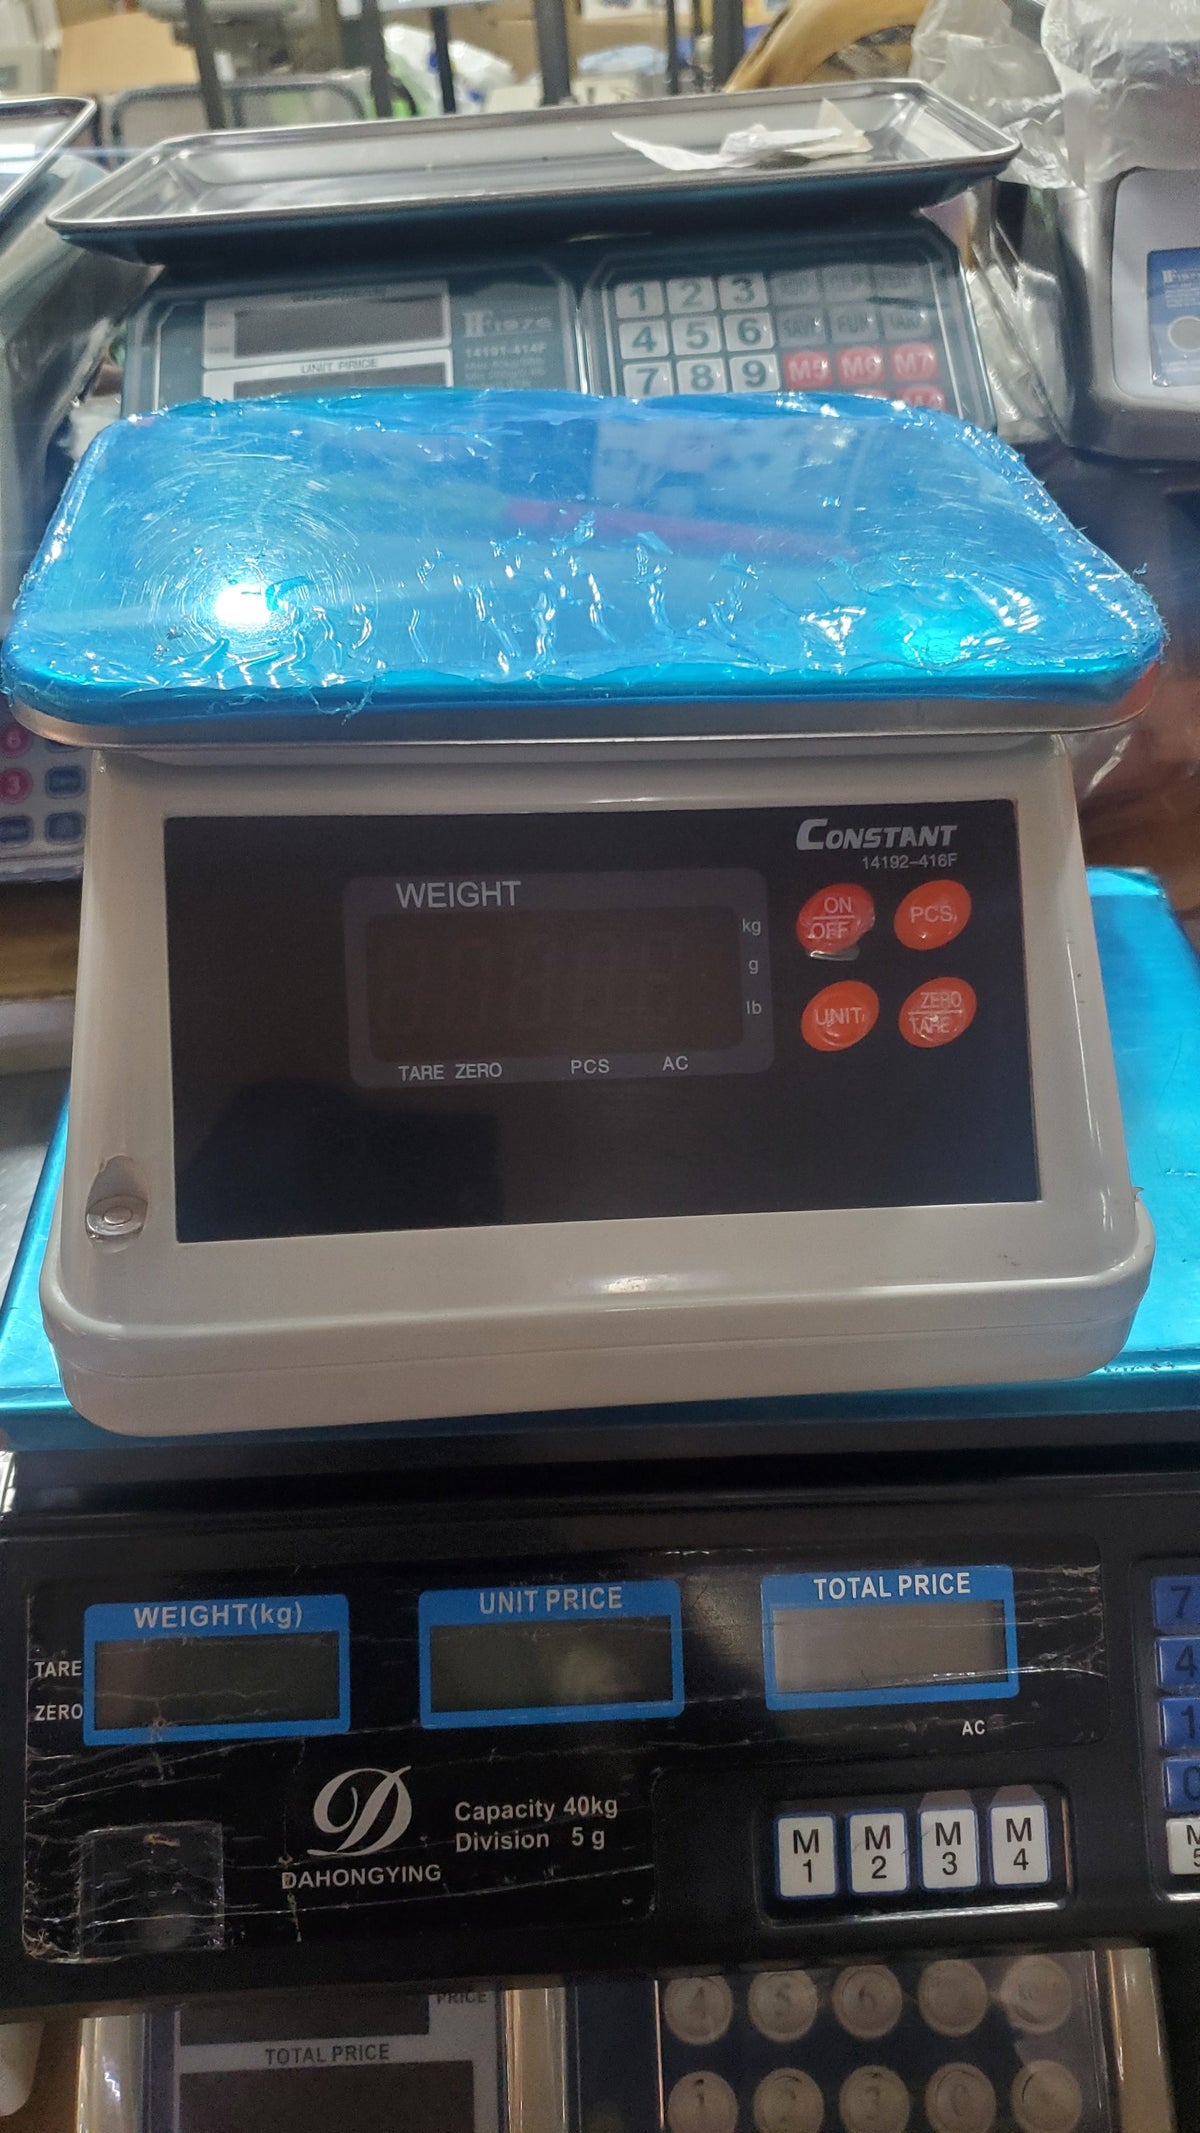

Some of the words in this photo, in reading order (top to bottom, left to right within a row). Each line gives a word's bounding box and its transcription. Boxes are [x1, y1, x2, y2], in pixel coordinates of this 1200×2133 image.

[629, 287, 646, 312] 1
[681, 281, 700, 308] 2
[734, 278, 755, 303] 3
[632, 326, 656, 351] 4
[686, 322, 709, 349] 5
[737, 318, 761, 345] 6
[301, 361, 332, 374] UNIT
[337, 358, 378, 370] PRICE
[894, 352, 935, 375] M7
[637, 368, 659, 395] 7
[690, 364, 714, 391] 8
[742, 360, 766, 387] 9
[796, 818, 958, 850] CONSTANT
[395, 880, 522, 909] WEIGHT
[823, 897, 853, 914] ON
[910, 905, 953, 924] PCS
[742, 918, 761, 936] kg
[811, 921, 849, 940] OFF
[748, 960, 759, 974] g
[746, 1000, 762, 1015] lb
[921, 990, 962, 1010] ZERO
[814, 1007, 863, 1026] UNIT
[909, 1017, 950, 1034] TARE
[399, 1065, 444, 1082] TARE
[455, 1062, 502, 1080] ZERO
[570, 1059, 610, 1075] PCS
[662, 1056, 689, 1071] AC
[814, 1575, 892, 1601] TOTAL
[898, 1572, 971, 1597] PRICE
[479, 1590, 542, 1615] UNIT
[546, 1586, 623, 1611] PRICE
[1171, 1585, 1192, 1619] 7
[133, 1601, 303, 1629] WEIGHT(kg)
[35, 1659, 82, 1678] TARE
[1175, 1644, 1198, 1679] 4
[35, 1704, 84, 1722] ZERO
[1181, 1705, 1196, 1739] 1
[961, 1719, 986, 1736] AC
[455, 1799, 555, 1825] Capacity
[563, 1795, 619, 1819] 40kg
[455, 1828, 550, 1853] Division
[572, 1827, 584, 1848] 5
[592, 1830, 606, 1852] g
[793, 1828, 820, 1854] M
[864, 1825, 891, 1851] M
[935, 1821, 962, 1847] M
[1006, 1817, 1033, 1843] M
[803, 1860, 814, 1884] 1
[871, 1856, 888, 1880] 2
[942, 1852, 958, 1876] 3
[1012, 1848, 1030, 1872] 4
[282, 1863, 442, 1891] DAHONGYING
[265, 2045, 327, 2067] TOTAL
[332, 2042, 391, 2063] PRICE
